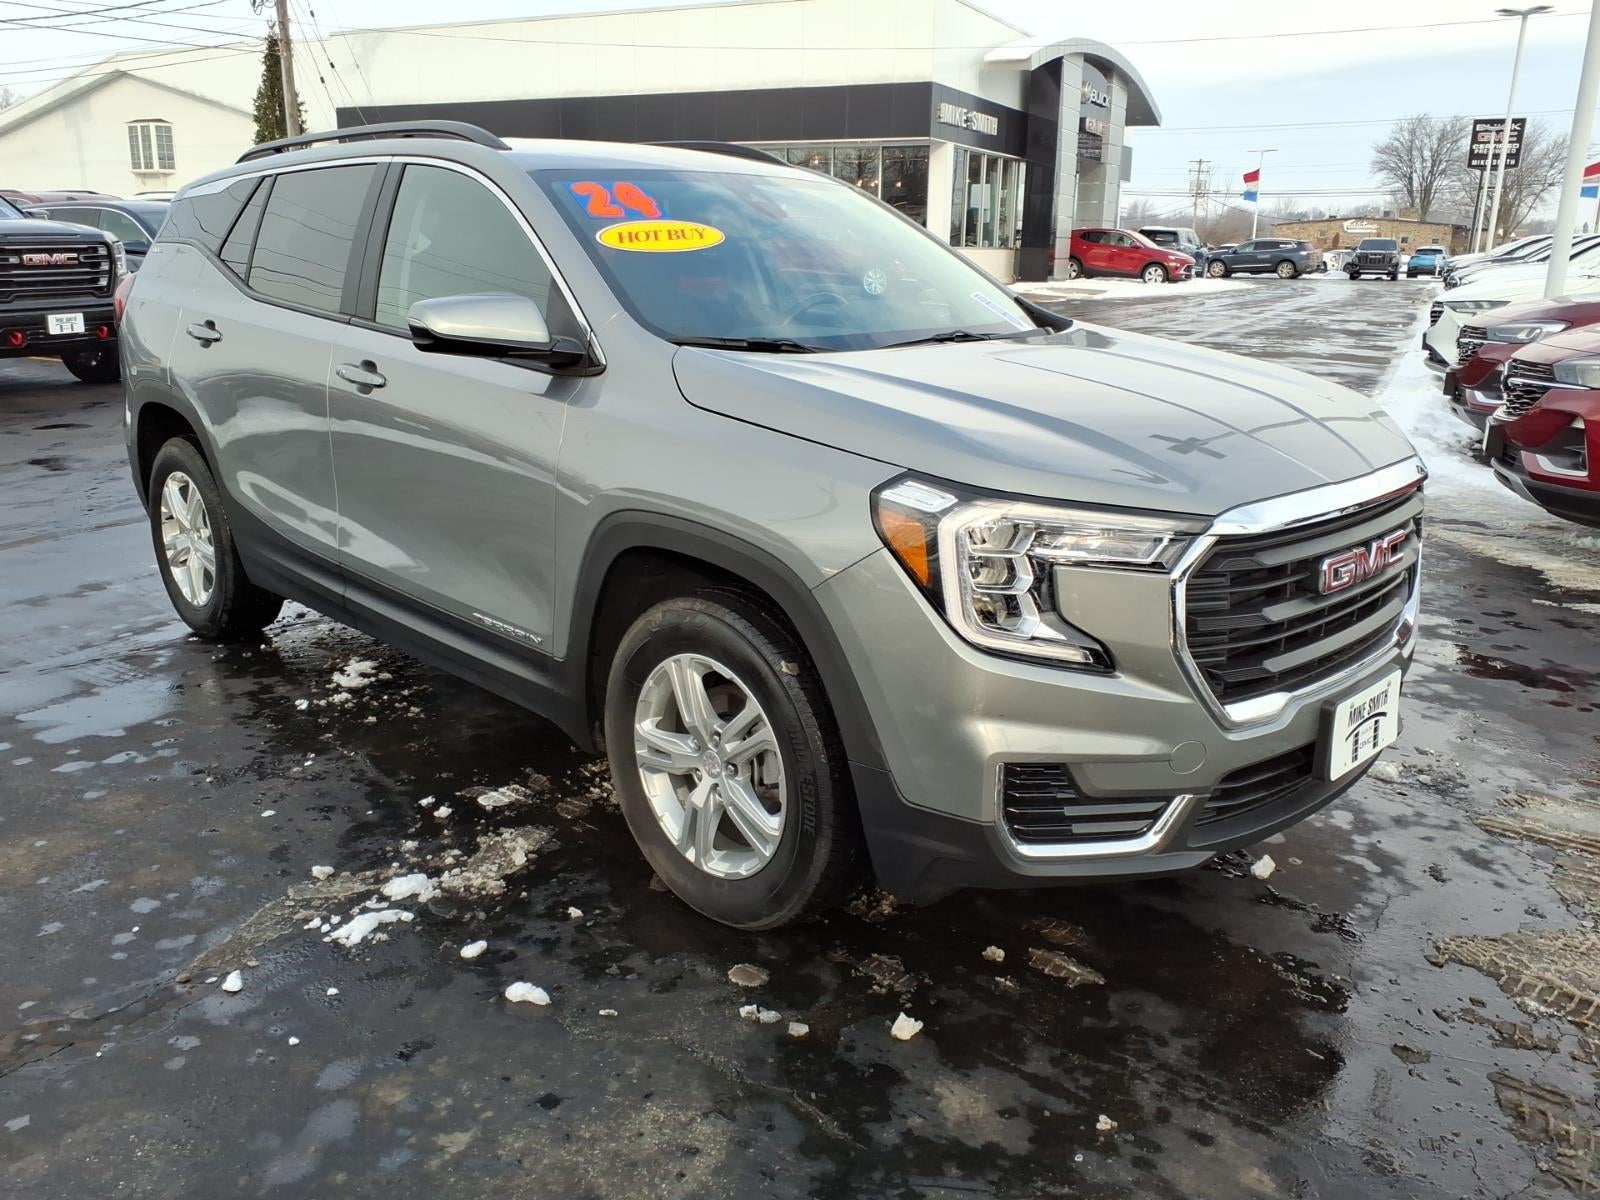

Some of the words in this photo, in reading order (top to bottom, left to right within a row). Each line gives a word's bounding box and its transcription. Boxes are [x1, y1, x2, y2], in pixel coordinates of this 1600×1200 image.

[940, 103, 967, 128] MIKE
[971, 111, 998, 136] SMITH
[571, 182, 662, 219] 24
[618, 231, 663, 244] HOT
[667, 228, 706, 242] BUY
[23, 253, 79, 266] GMC
[1319, 530, 1406, 595] GMC
[1348, 702, 1367, 728] MIKE
[1367, 688, 1389, 716] SMITH
